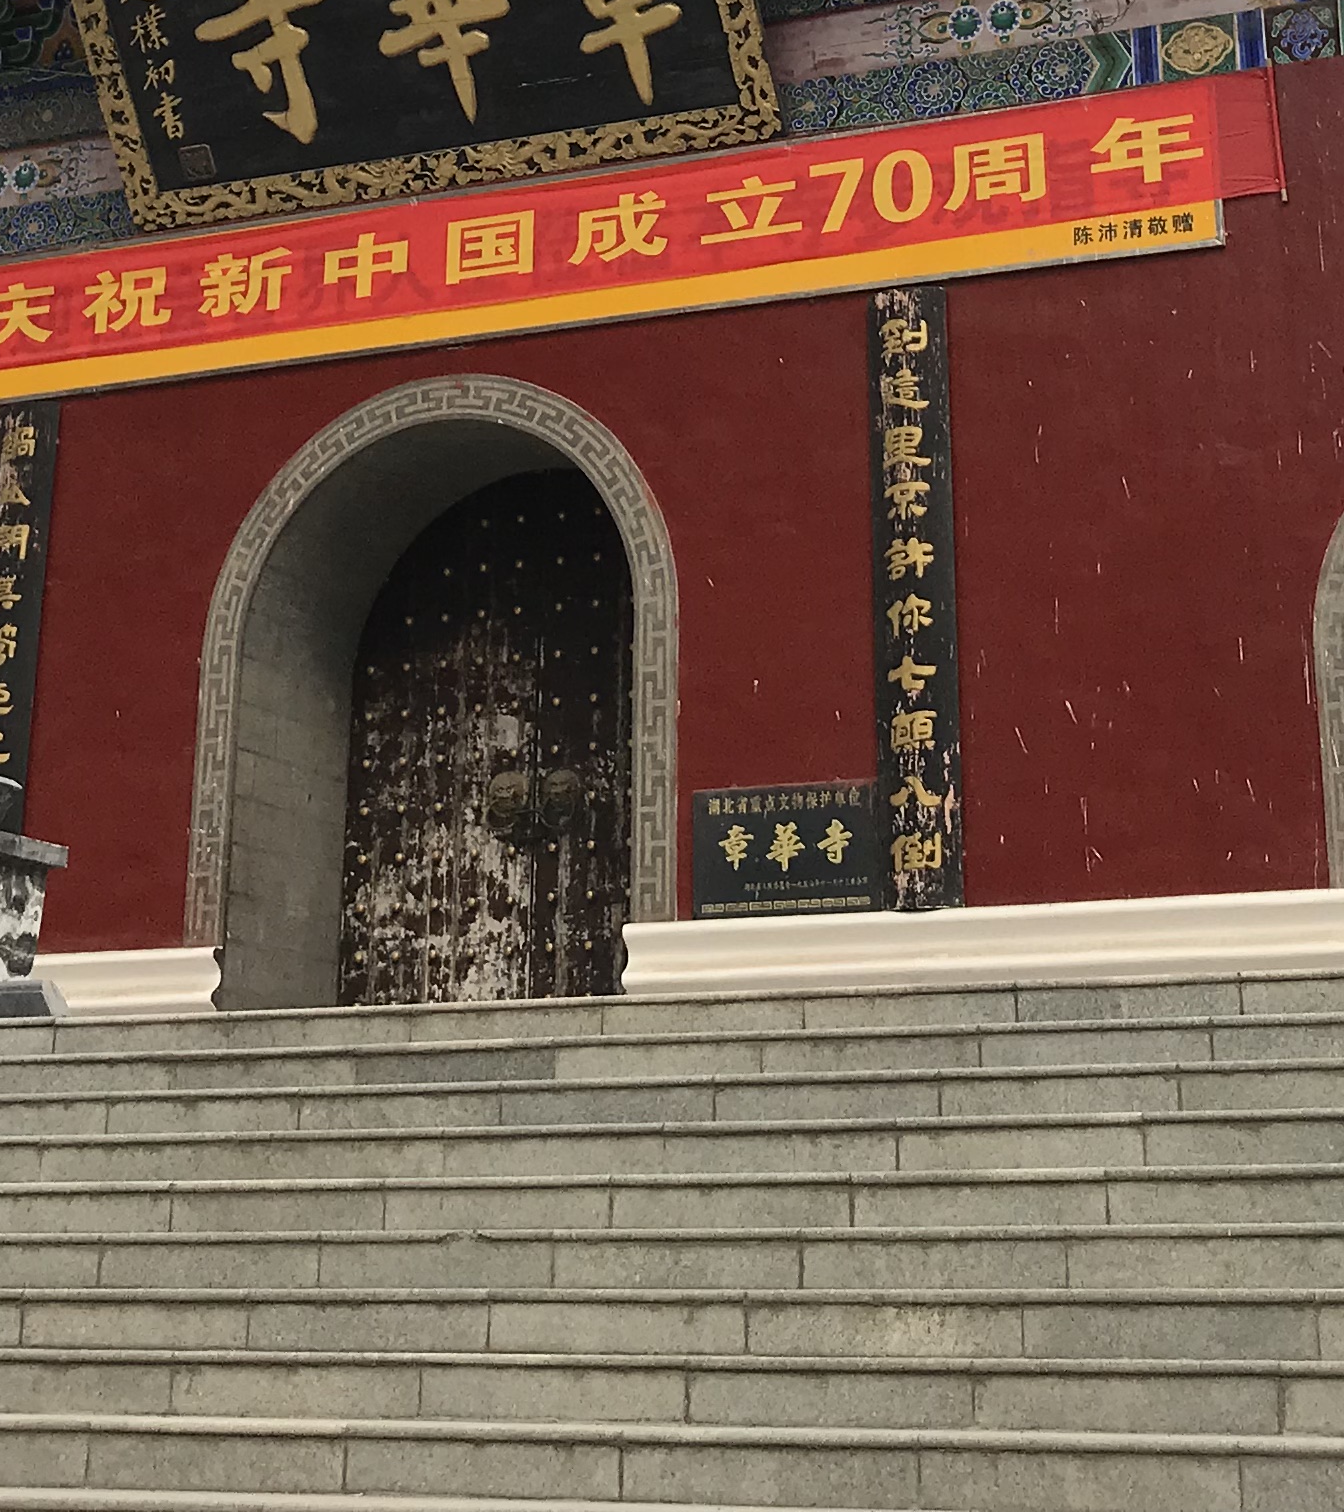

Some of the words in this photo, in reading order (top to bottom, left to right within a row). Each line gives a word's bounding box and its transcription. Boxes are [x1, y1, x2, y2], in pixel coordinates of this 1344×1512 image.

[1073, 211, 1194, 246] 陈沛清敬赠
